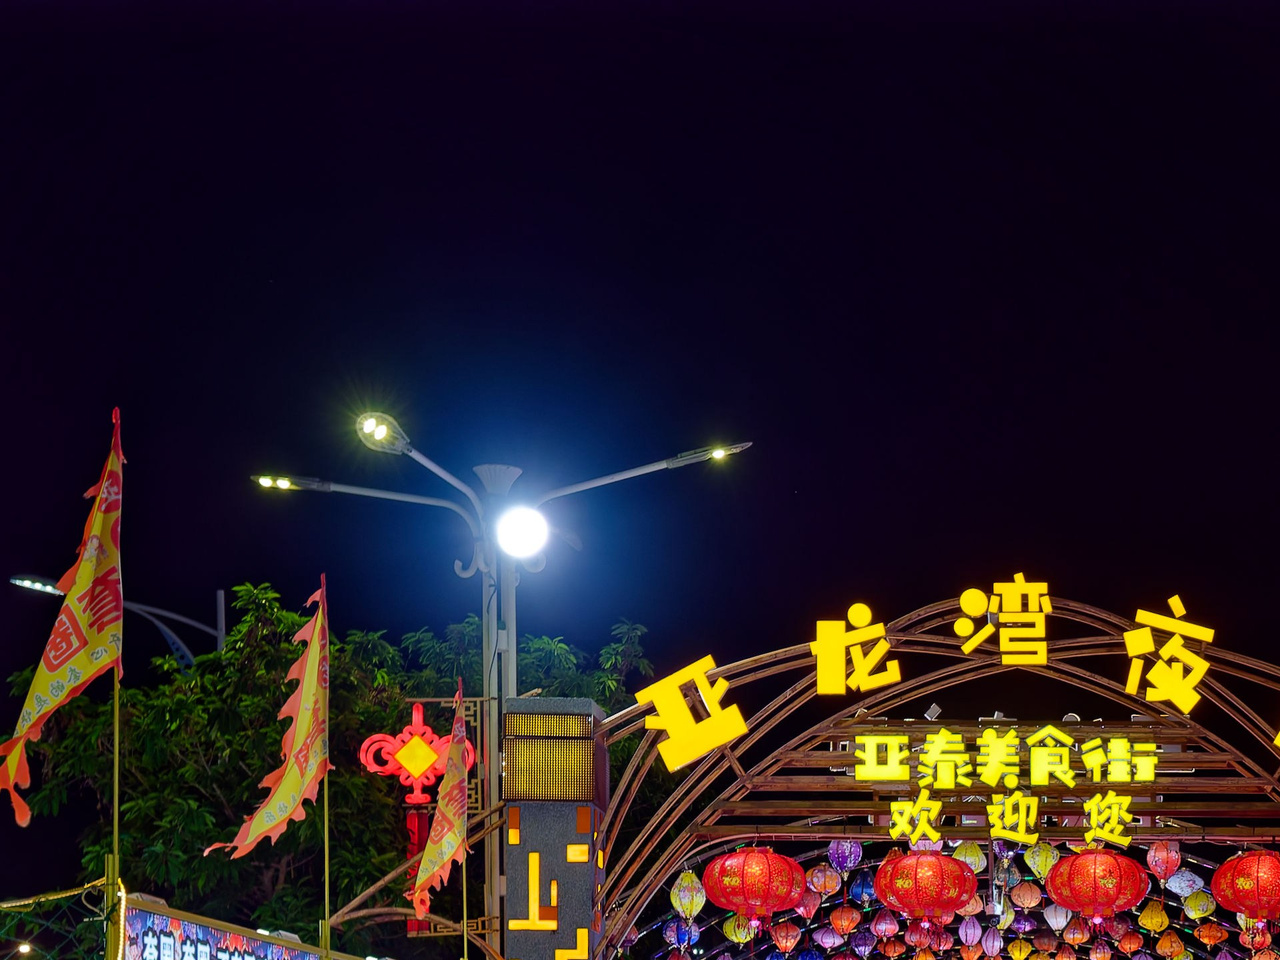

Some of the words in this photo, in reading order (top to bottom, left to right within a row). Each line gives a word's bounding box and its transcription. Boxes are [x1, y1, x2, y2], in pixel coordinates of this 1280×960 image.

[854, 725, 1158, 789] 亚泰美食街
[889, 788, 1133, 847] 欢迎您
